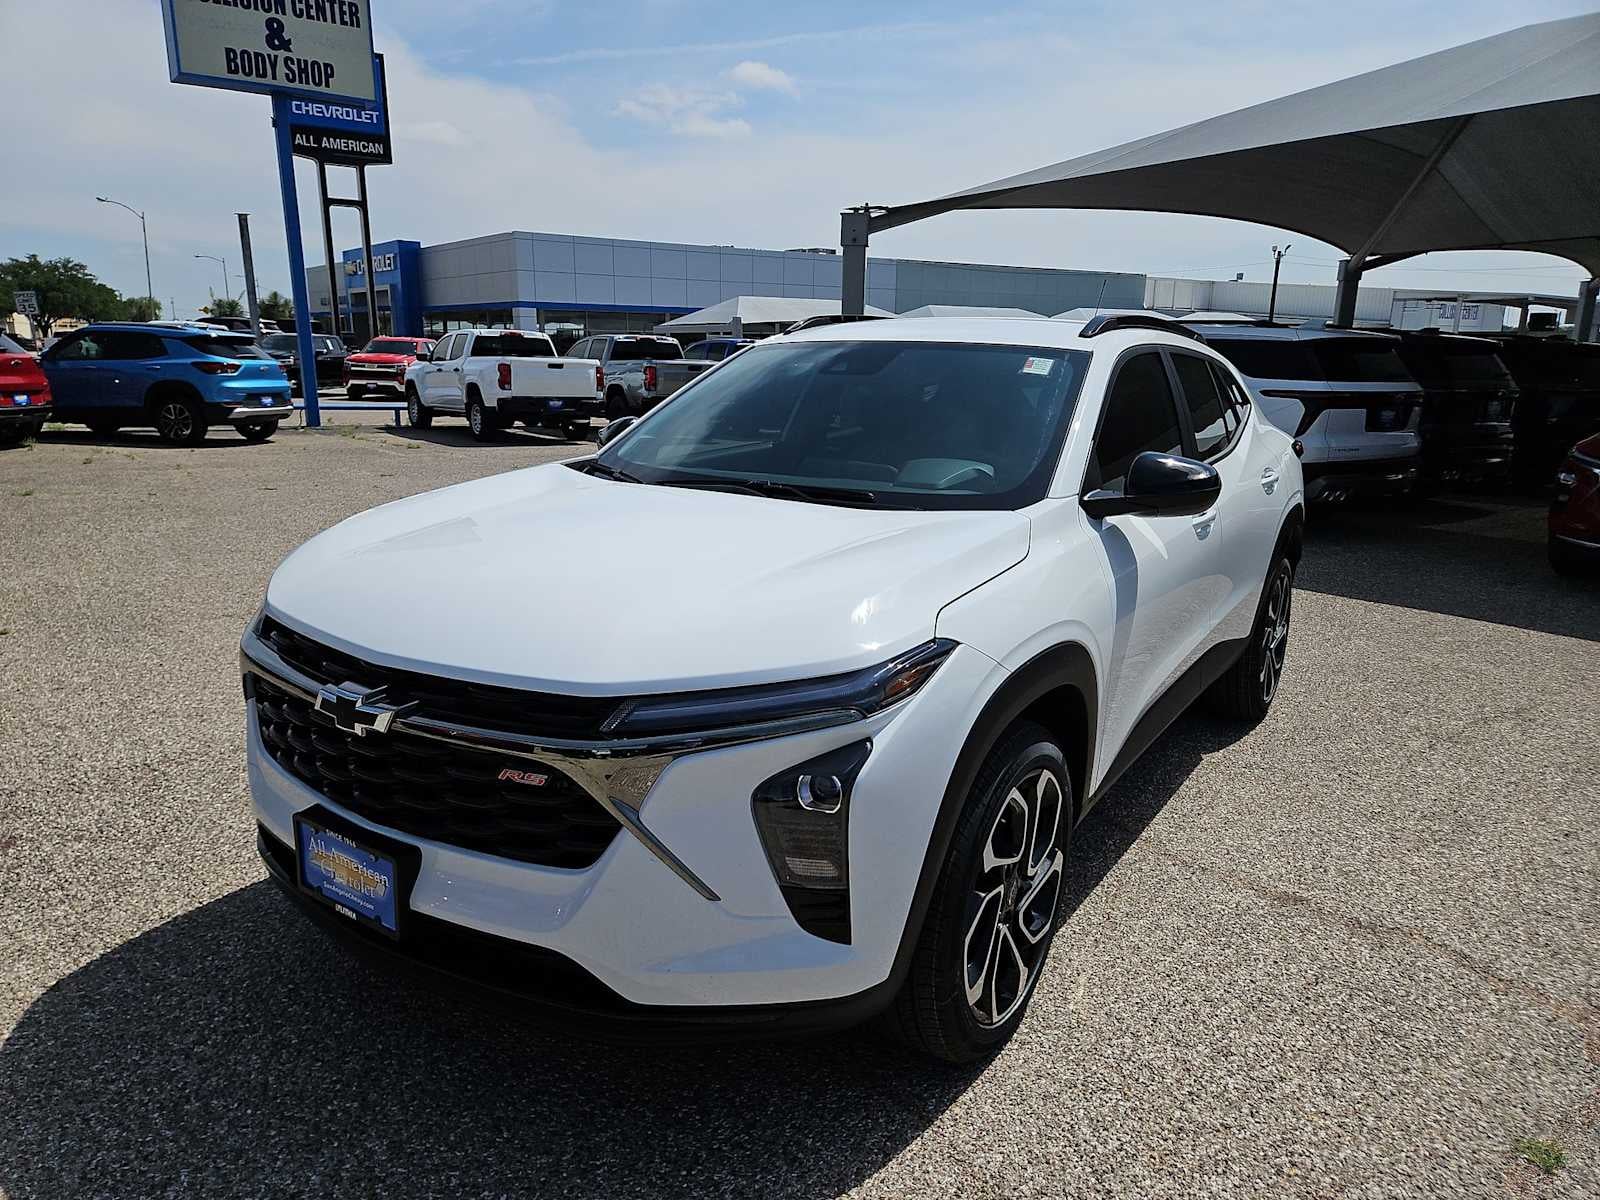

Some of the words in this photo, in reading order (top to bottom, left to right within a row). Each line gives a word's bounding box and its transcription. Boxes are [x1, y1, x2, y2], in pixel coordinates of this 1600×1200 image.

[291, 0, 360, 28] CENTER
[265, 17, 293, 52] &
[224, 47, 279, 81] BODY
[283, 56, 335, 88] SHOP
[291, 101, 379, 124] CHEVROLET
[295, 133, 318, 147] ALL
[322, 137, 384, 154] AMERICAN
[356, 253, 395, 275] CHROLET
[18, 303, 36, 313] 35
[498, 768, 548, 786] RS
[308, 837, 326, 855] All
[328, 848, 389, 887] American
